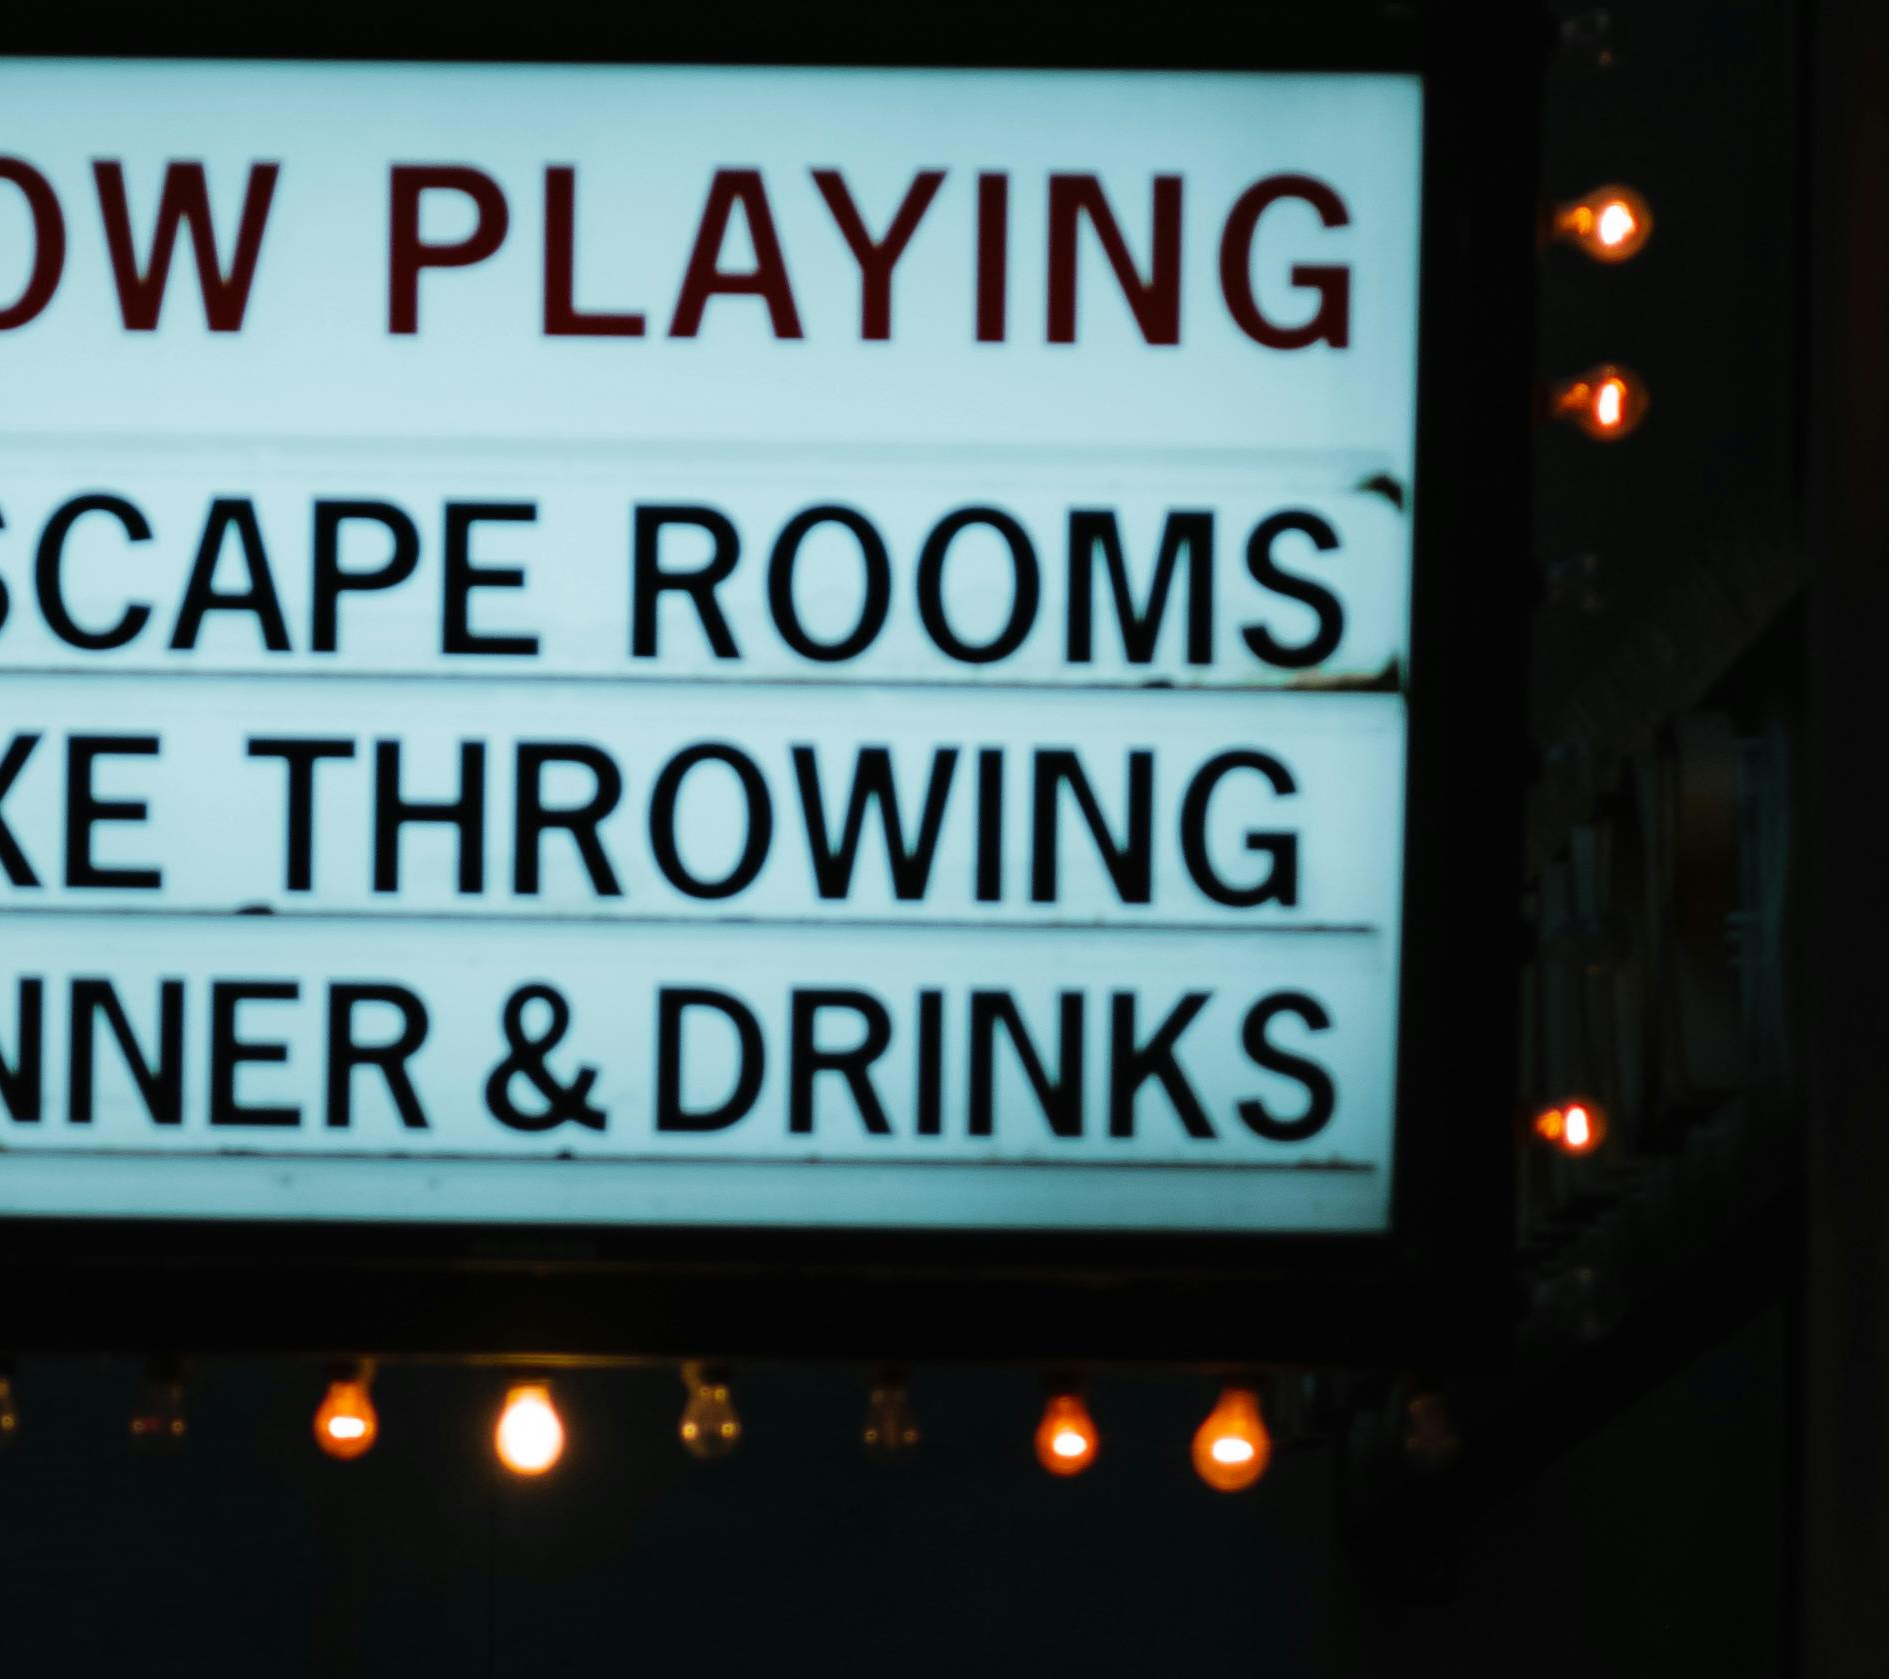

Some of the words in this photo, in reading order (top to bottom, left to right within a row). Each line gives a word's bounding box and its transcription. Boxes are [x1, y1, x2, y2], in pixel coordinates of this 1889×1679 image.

[389, 165, 1350, 350] PLAYING
[633, 505, 1344, 670] ROOMS
[248, 739, 1297, 908] THROWING
[485, 984, 607, 1132] &
[656, 988, 1336, 1144] DRINKS
